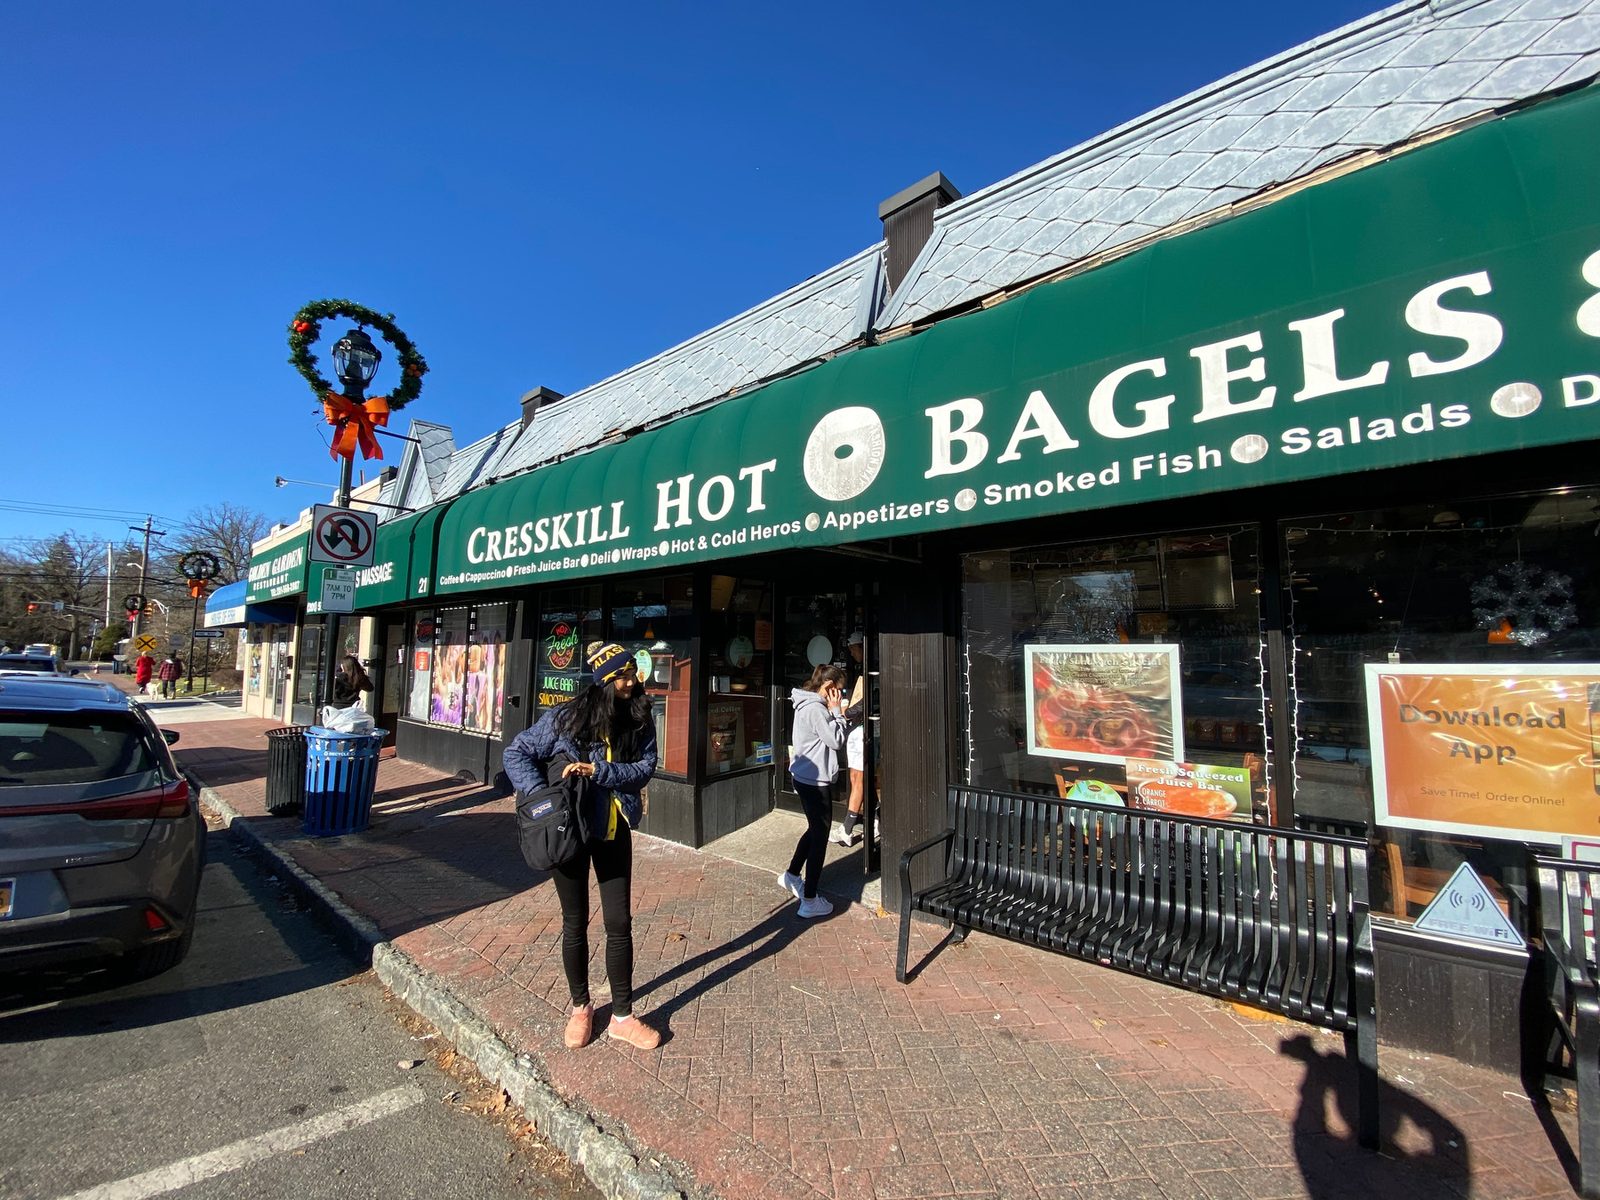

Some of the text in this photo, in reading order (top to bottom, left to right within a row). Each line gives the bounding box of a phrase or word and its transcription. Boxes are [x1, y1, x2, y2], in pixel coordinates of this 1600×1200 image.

[467, 501, 630, 564] CRESSKILL
[654, 459, 777, 532] HOT
[925, 271, 1503, 479] BAGELS
[440, 573, 460, 586] Coffee
[465, 568, 506, 583] Cappuccino
[513, 563, 537, 575] Fresh
[537, 560, 561, 572] Juice
[563, 556, 580, 569] Bar
[590, 550, 611, 566] Deli
[620, 546, 658, 564] Wraps
[671, 537, 695, 554] Hot
[697, 535, 708, 550] &
[711, 528, 747, 548] Cold
[750, 520, 801, 541] Heros
[823, 498, 950, 531] Appetizers
[983, 461, 1120, 506] Smoked
[1132, 445, 1222, 481] Fish
[1280, 403, 1472, 455] Salads
[361, 561, 394, 587] MASSAGE
[326, 583, 352, 593] 7AM TO
[418, 577, 428, 594] 21
[331, 592, 346, 600] 7PM
[545, 626, 579, 657] Fresh
[542, 676, 574, 692] JUICE BAR
[1400, 704, 1566, 729] Download
[1450, 740, 1517, 765] App
[1137, 764, 1244, 783] Fresh Squeezed
[1141, 787, 1167, 798] ORANGE
[1157, 778, 1223, 791] Juice Bar
[1142, 797, 1165, 807] CARROT
[1420, 786, 1566, 807] Save Time! Order Online!
[1429, 919, 1469, 932] FREE
